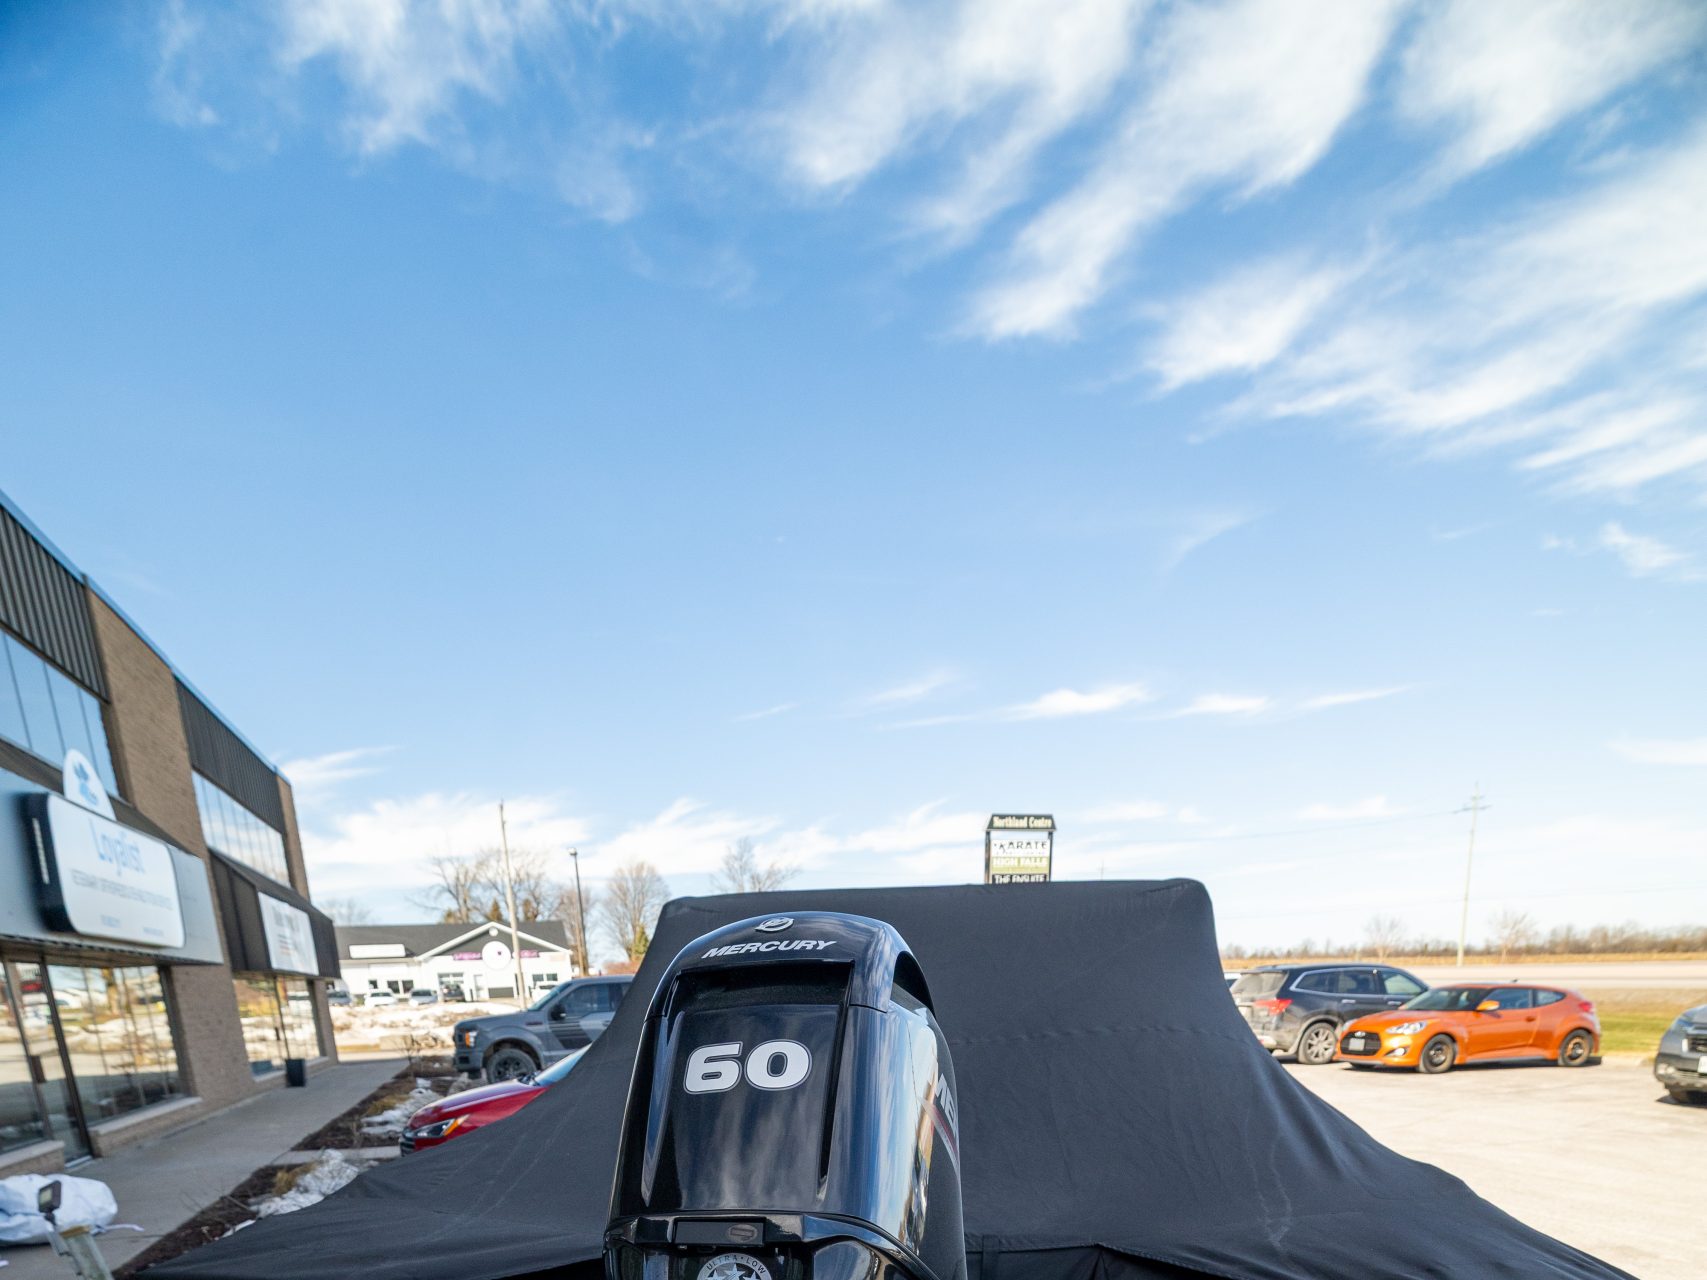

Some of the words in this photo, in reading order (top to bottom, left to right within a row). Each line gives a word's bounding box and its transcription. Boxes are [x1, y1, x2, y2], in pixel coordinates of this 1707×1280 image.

[701, 939, 837, 960] MERCURY
[683, 1038, 813, 1095] 60
[706, 1254, 738, 1271] ULTRA
[746, 1256, 767, 1275] LOW
